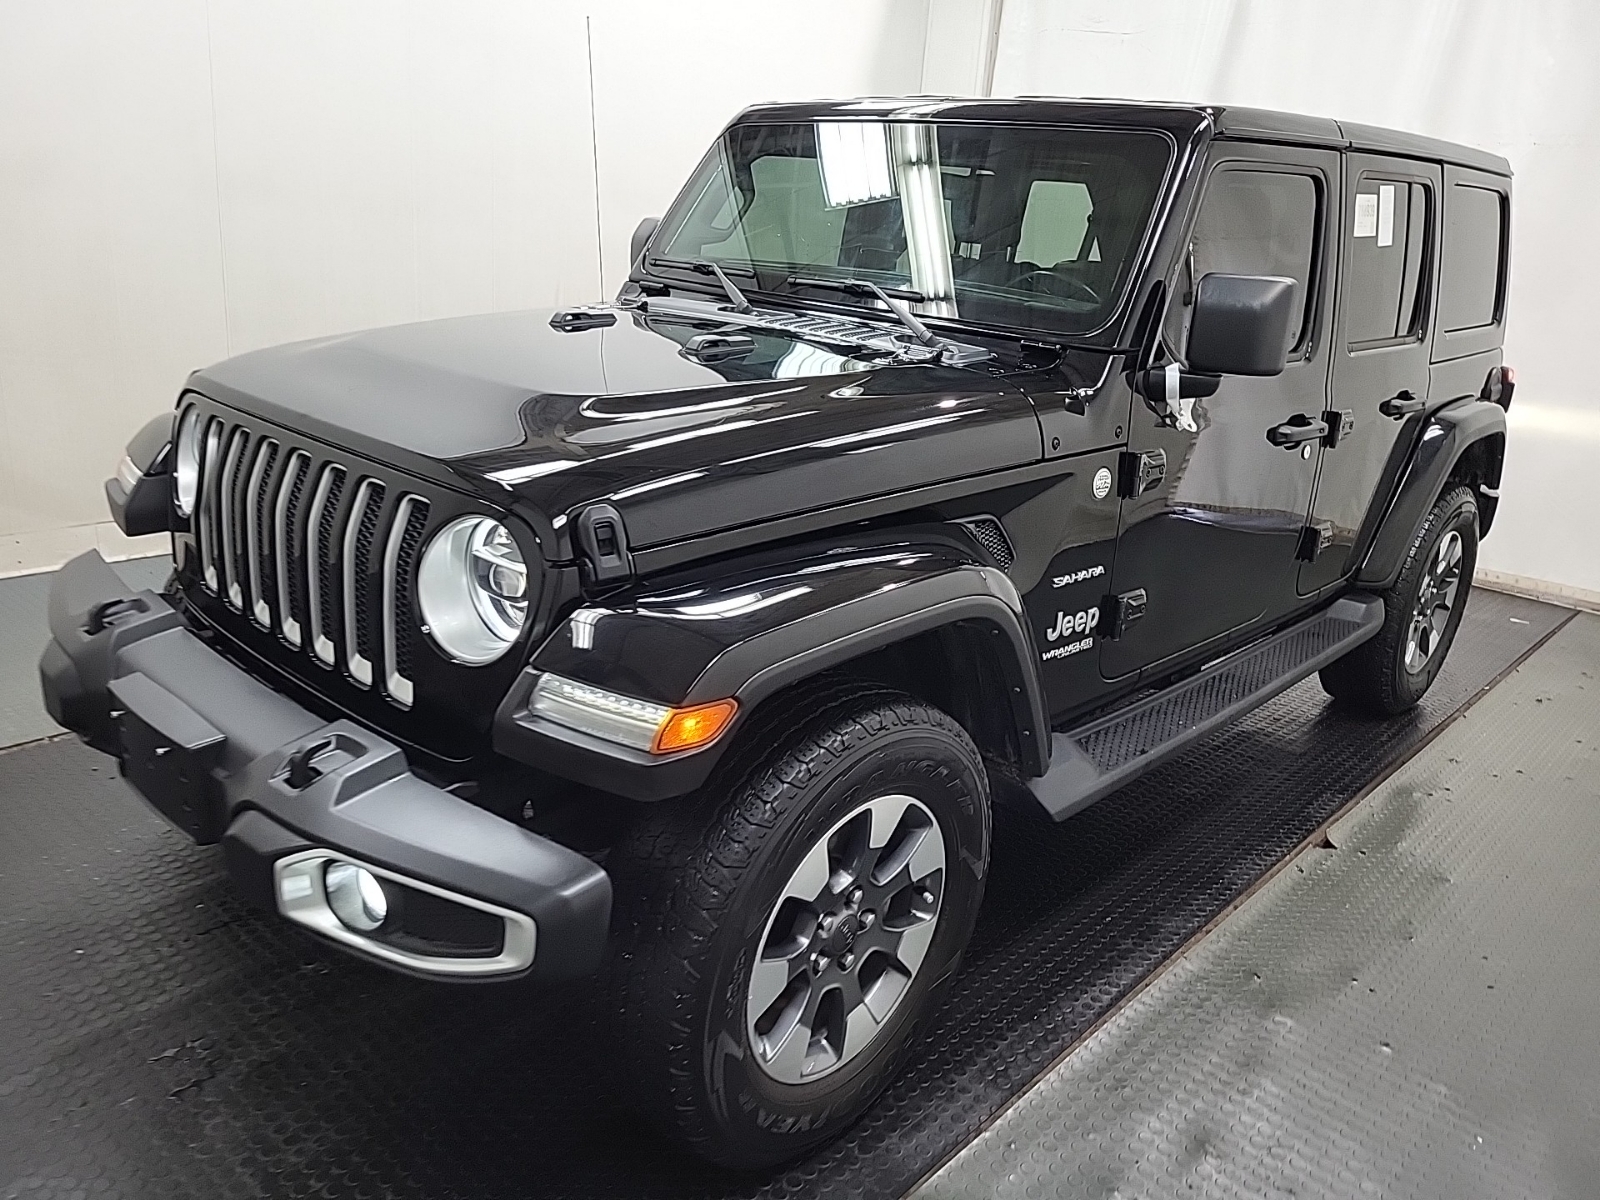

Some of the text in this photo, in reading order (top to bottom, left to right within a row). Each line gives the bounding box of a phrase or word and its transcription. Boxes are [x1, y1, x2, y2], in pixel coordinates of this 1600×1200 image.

[1052, 565, 1105, 588] SAHARA
[1046, 606, 1100, 642] Jeep
[1042, 637, 1093, 661] WRANGLER
